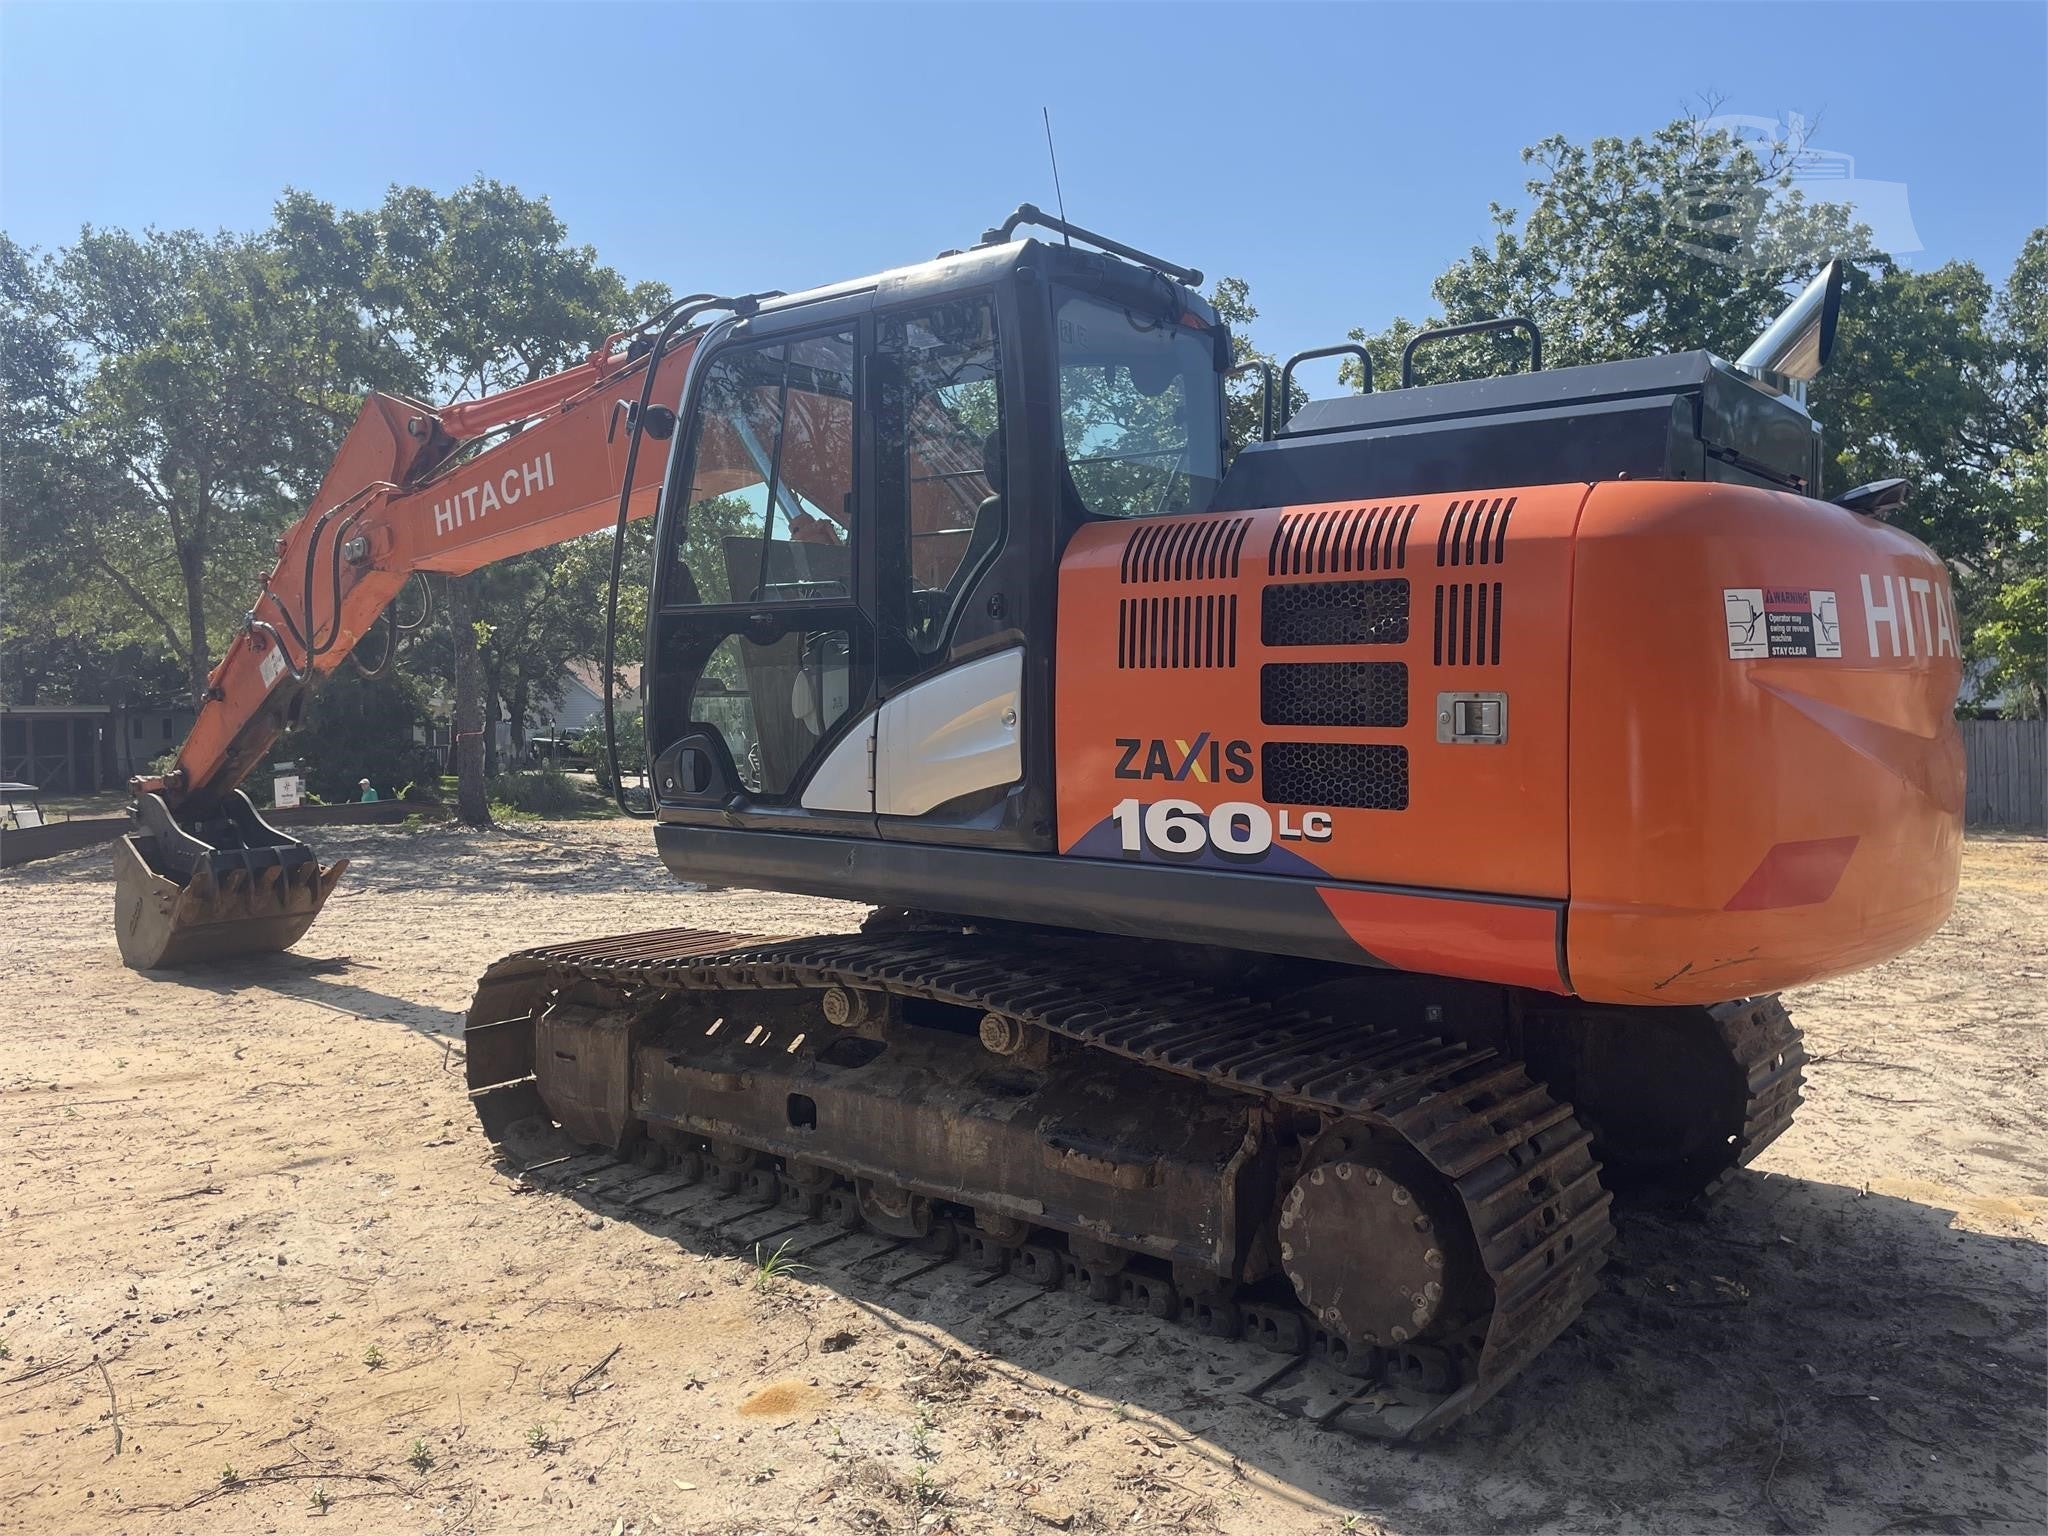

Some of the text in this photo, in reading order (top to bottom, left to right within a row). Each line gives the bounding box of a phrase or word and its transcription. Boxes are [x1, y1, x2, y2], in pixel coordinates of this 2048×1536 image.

[433, 451, 554, 536] HITACHI
[1774, 590, 1808, 604] WARNING
[1768, 613, 1802, 625] Operator may
[1770, 624, 1810, 634] swing or reverse
[1770, 634, 1793, 643] machine
[1772, 646, 1808, 656] STAY CLEAR
[1115, 732, 1254, 784] ZAXIS
[1112, 798, 1333, 860] 160 LC
